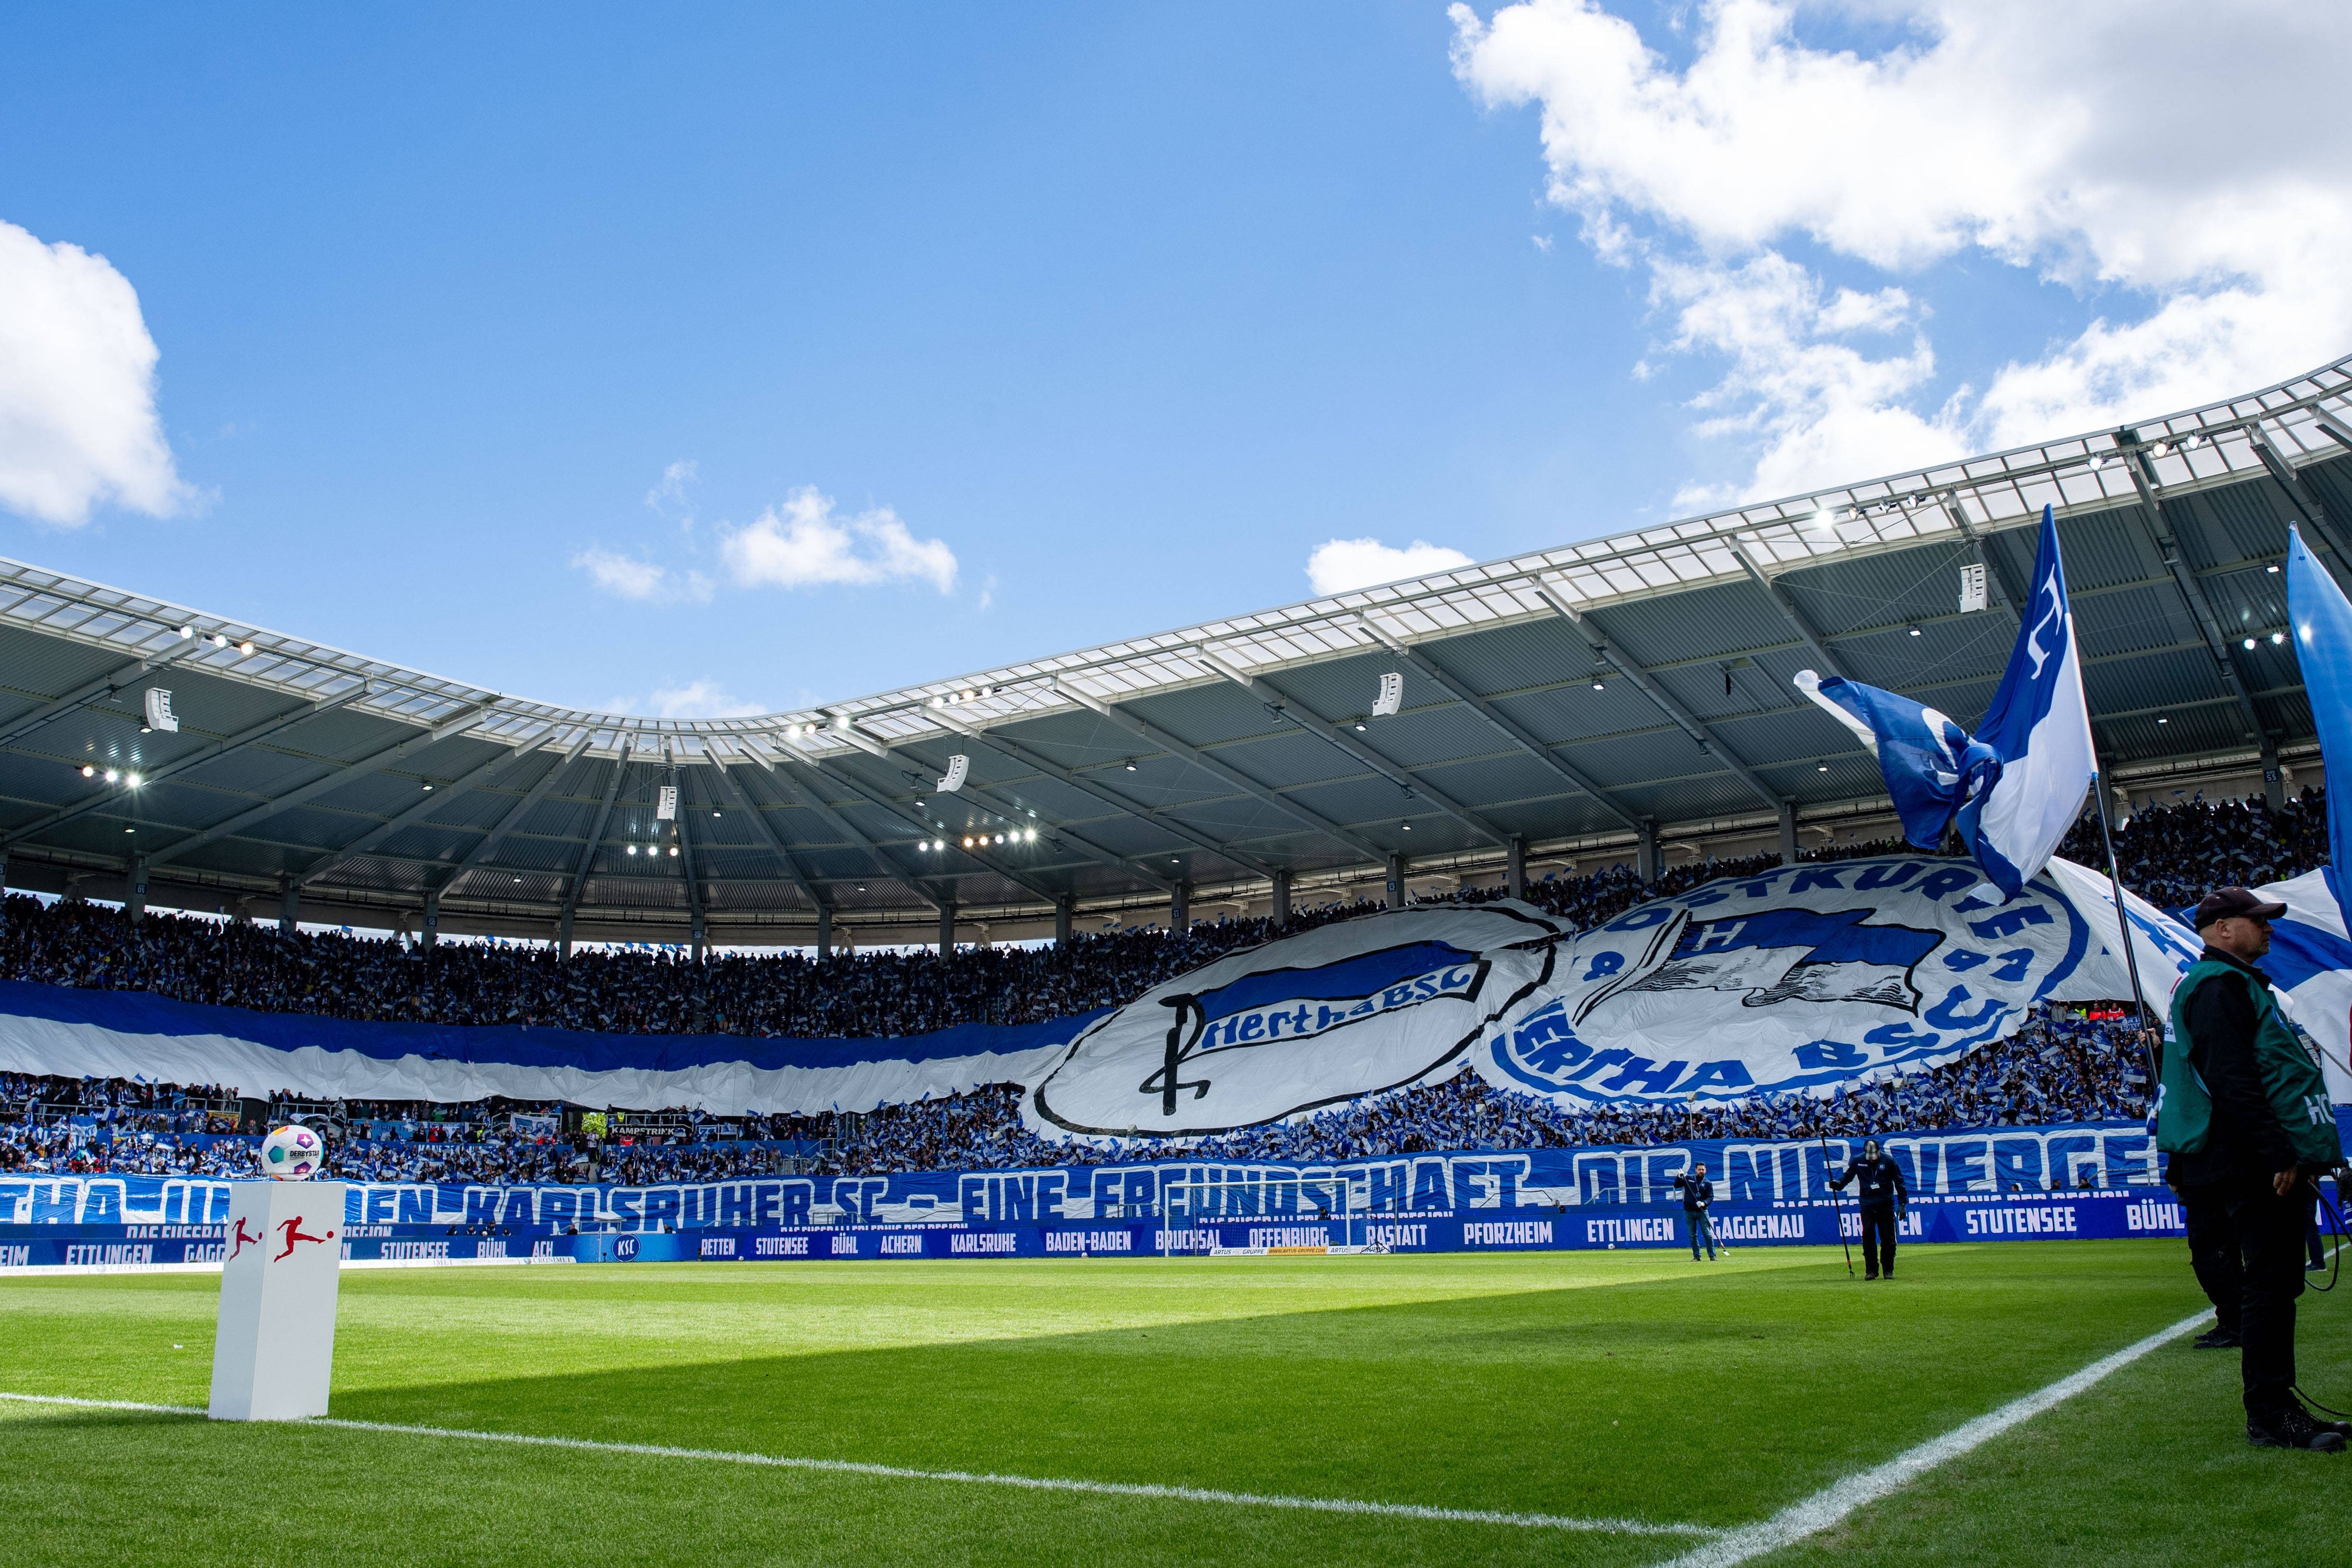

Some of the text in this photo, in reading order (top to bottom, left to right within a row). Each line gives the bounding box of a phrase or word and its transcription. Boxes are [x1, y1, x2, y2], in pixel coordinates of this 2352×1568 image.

[1604, 862, 2054, 939] OSTKURVE
[1695, 921, 1748, 952] H
[1201, 964, 1472, 1049] Hertha BSC
[1792, 985, 2008, 1069] BSC
[462, 1179, 816, 1235] KARLSRUHER
[831, 1176, 888, 1223] SC
[958, 1170, 1068, 1221] EINE
[1092, 1154, 1531, 1218] FREUNDSCHAFT
[1573, 1148, 1691, 1204] DIE
[1723, 1139, 1851, 1199] NIE
[1883, 1127, 2160, 1194] VERGE
[66, 1245, 153, 1265] ETTLINGEN
[184, 1244, 226, 1262] GAGG
[381, 1237, 554, 1259] STUTENSEE BÜHL ACH
[617, 1239, 634, 1256] KSC
[701, 1199, 2185, 1255] RETTEN STUTENSEE BÜHL ACHERN KARLSRUHE BADEN-BADEN BRUCHSAL OFFENBURG RASTATT PFORZHEIM ETTLINGEN GAGGENAU BREN STUTENSEE BÜHL
